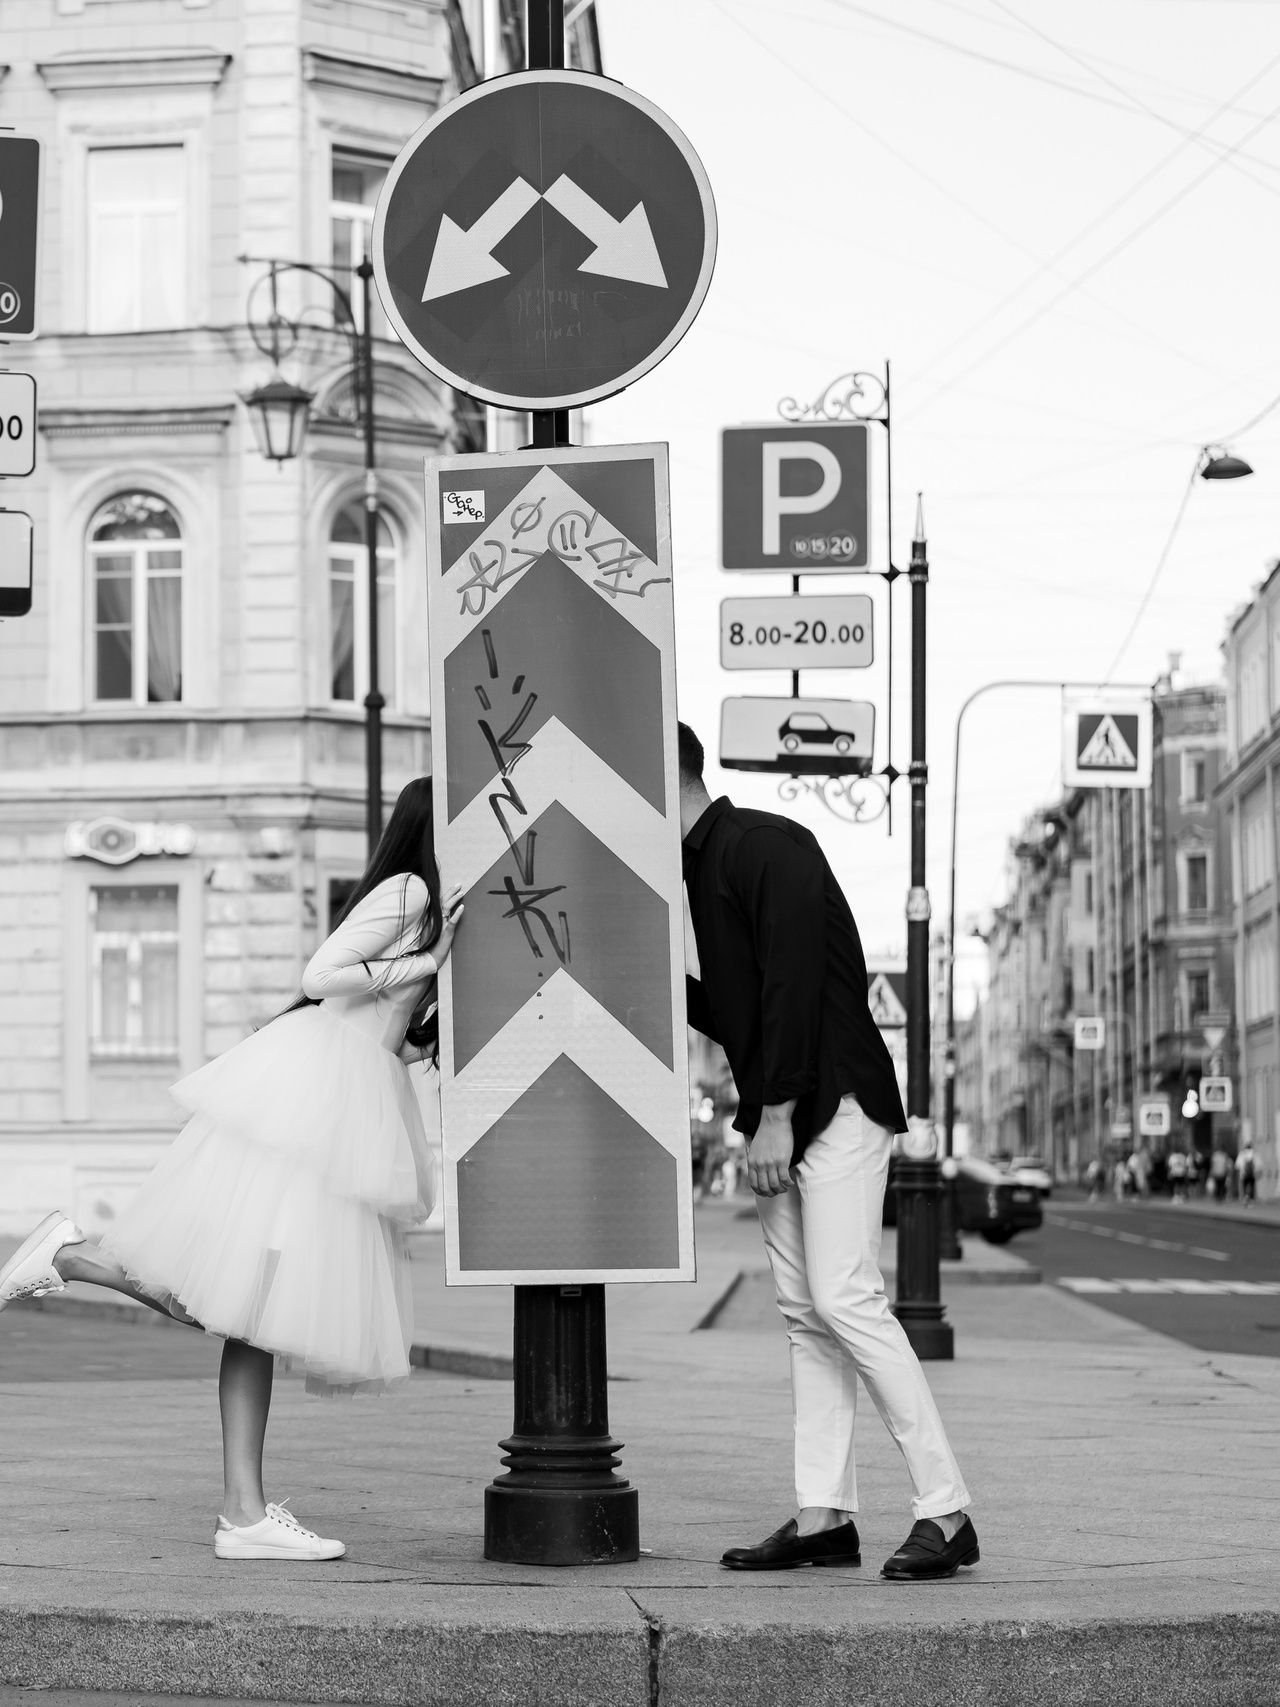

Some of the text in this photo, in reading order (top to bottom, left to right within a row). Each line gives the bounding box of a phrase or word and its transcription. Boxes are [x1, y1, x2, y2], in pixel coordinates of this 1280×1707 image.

[762, 441, 842, 555] P
[829, 535, 854, 555] 20
[728, 620, 865, 646] 8.00-20.00
